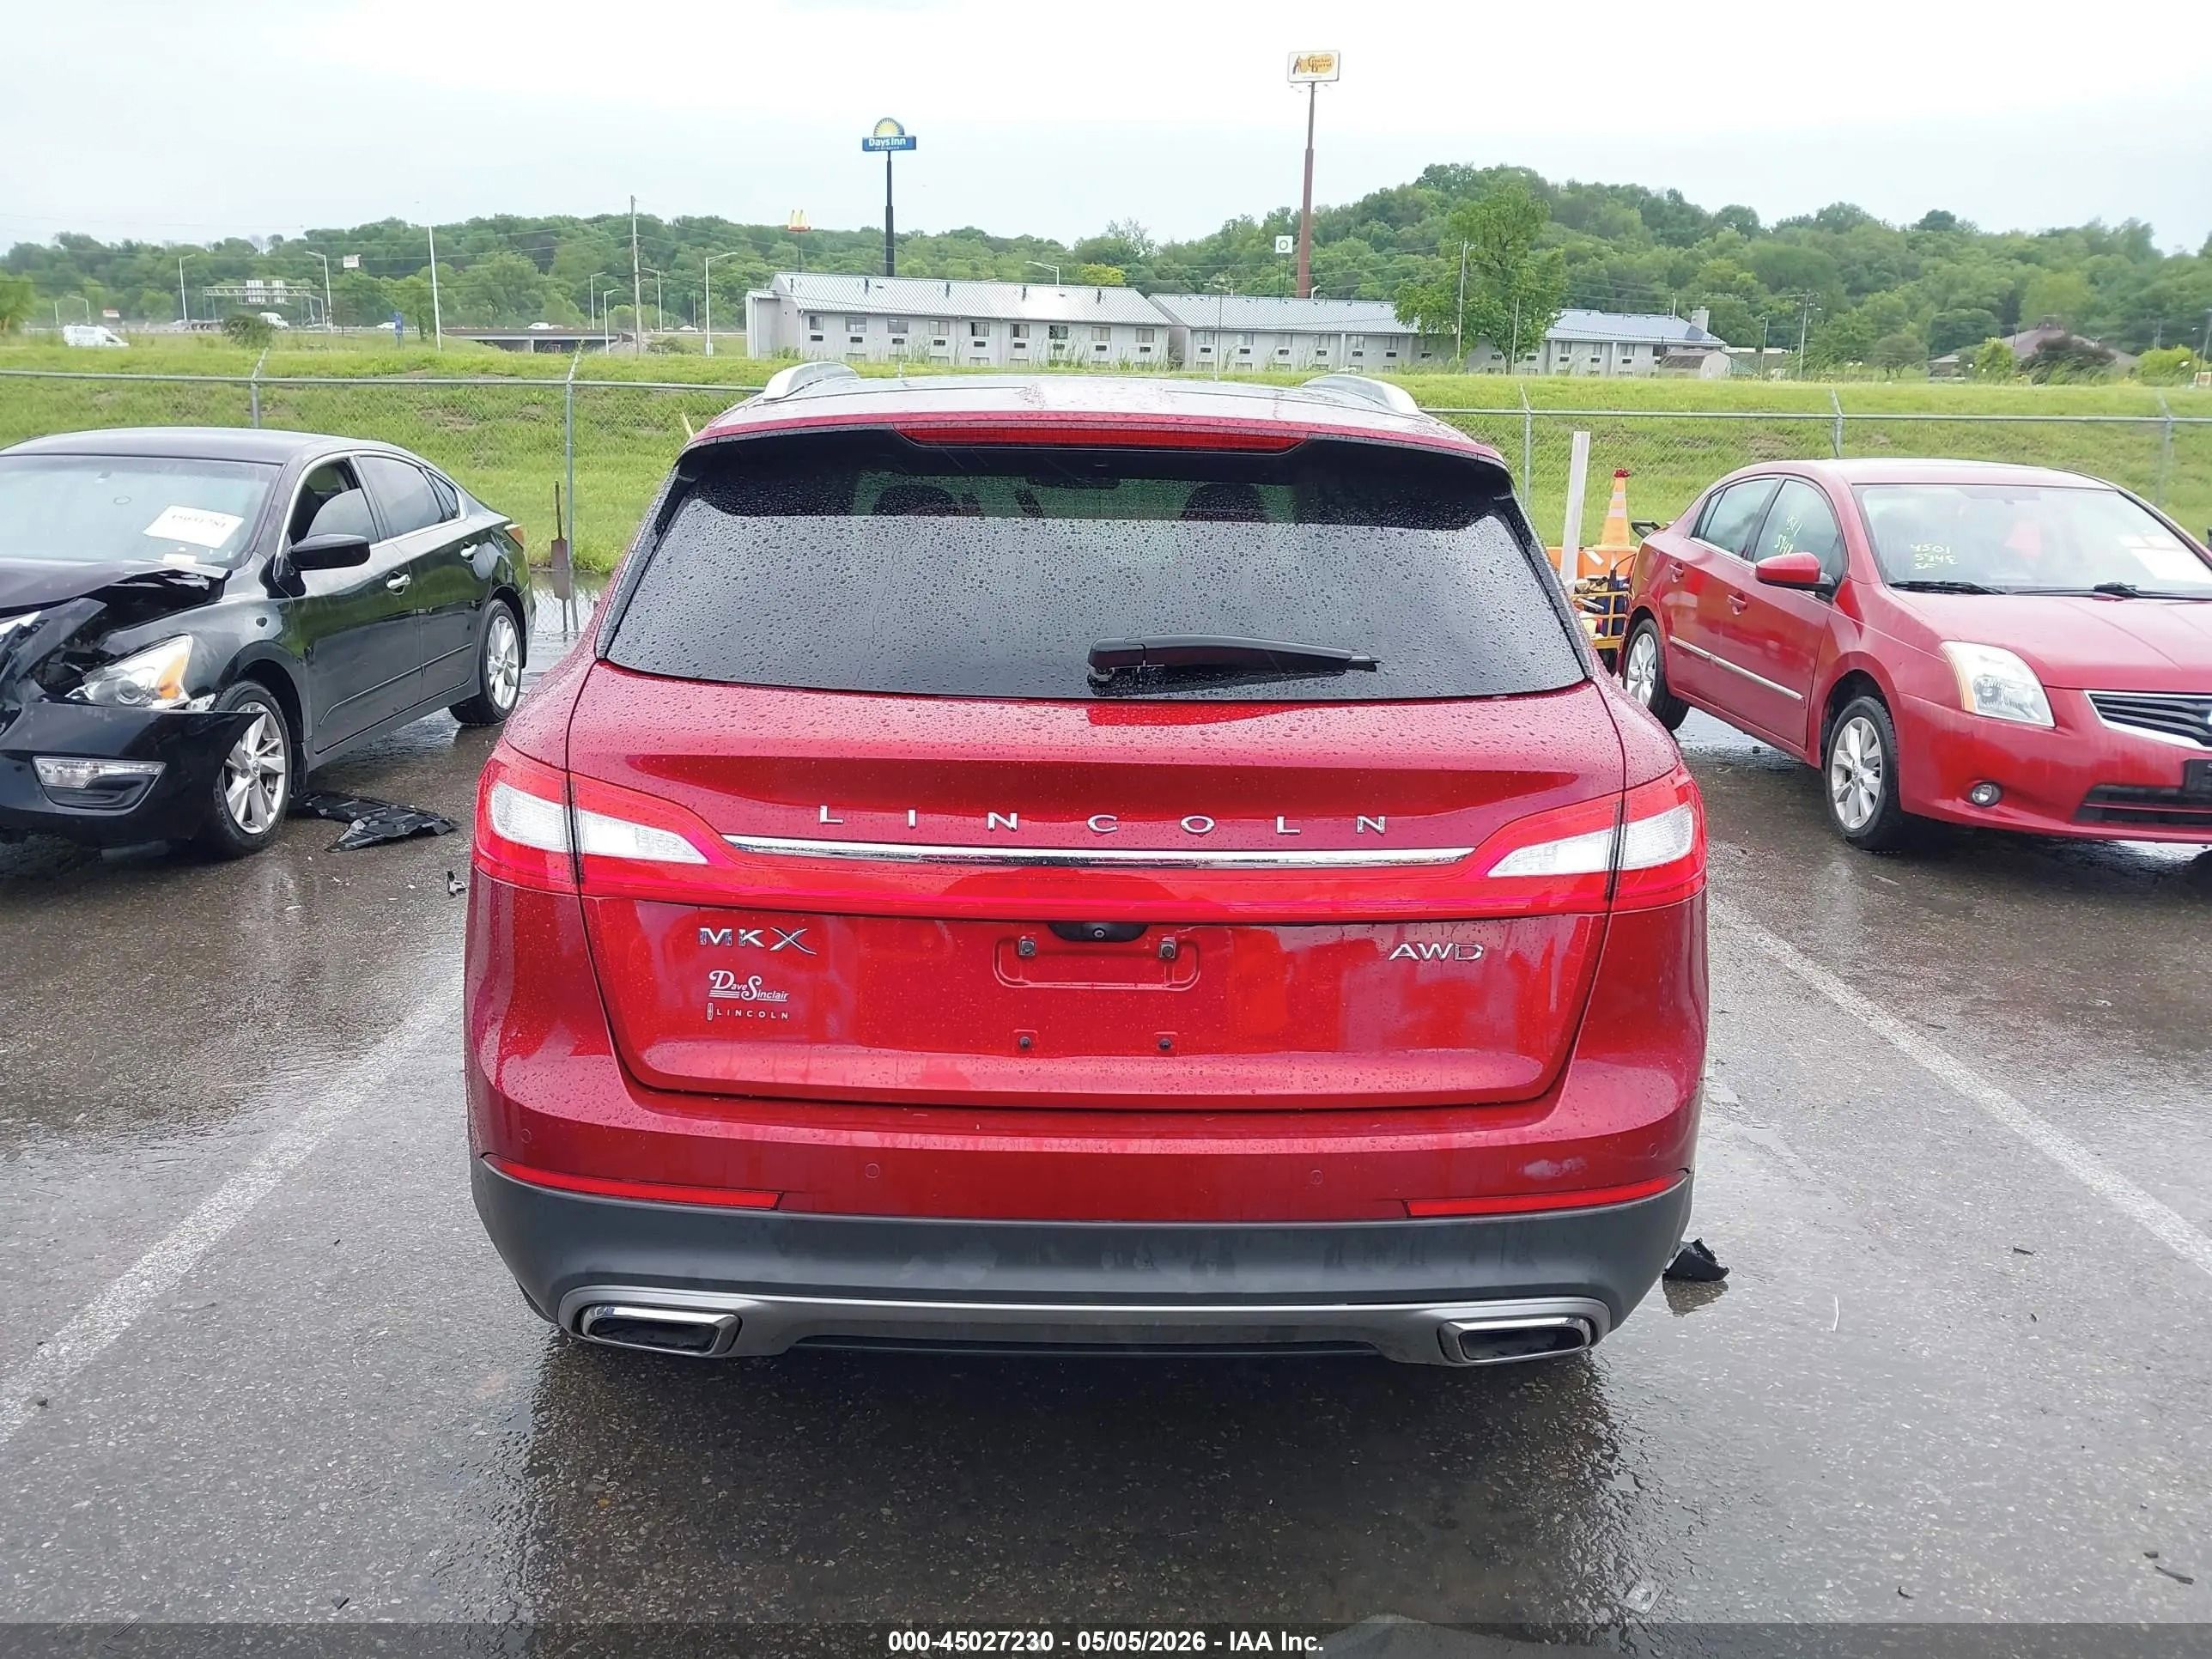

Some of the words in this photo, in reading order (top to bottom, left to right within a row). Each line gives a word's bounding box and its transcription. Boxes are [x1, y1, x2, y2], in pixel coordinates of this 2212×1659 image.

[868, 137, 890, 147] Days
[890, 137, 907, 145] Inn
[818, 805, 1386, 835] LINCOLN
[699, 927, 817, 955] MKX
[1388, 942, 1485, 961] AWD
[708, 969, 747, 990] Dave
[740, 975, 790, 1001] Sinclair
[716, 1008, 789, 1020] LINCOLN
